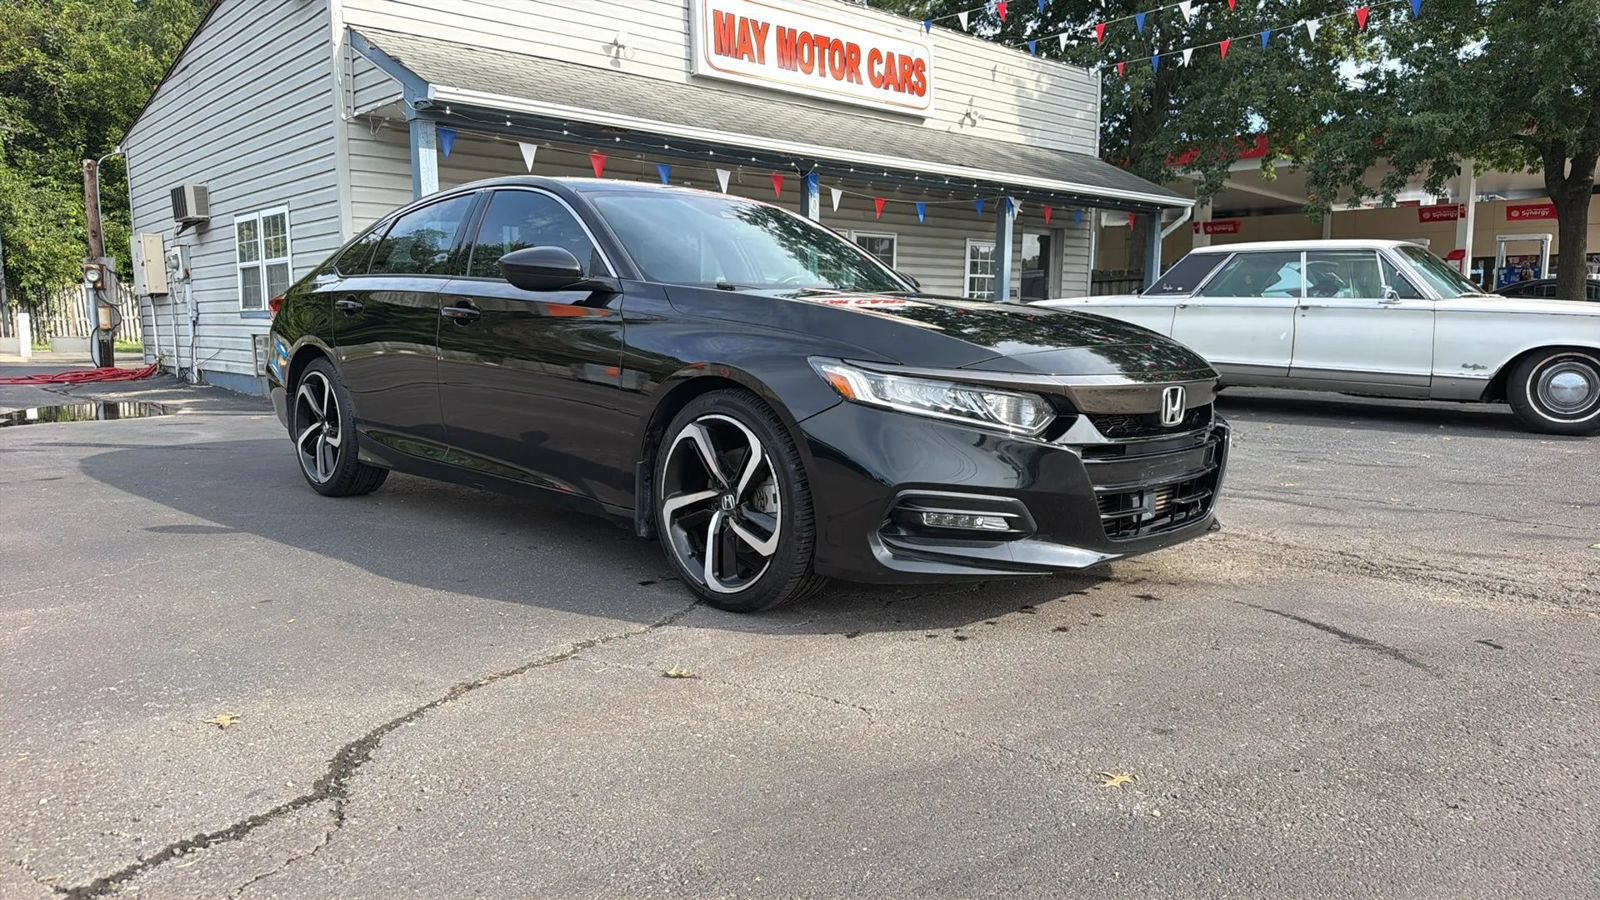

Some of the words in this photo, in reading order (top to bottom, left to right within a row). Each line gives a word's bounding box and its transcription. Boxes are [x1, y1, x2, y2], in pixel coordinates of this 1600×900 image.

[713, 9, 770, 65] MAY
[776, 25, 863, 85] MOTOR
[867, 47, 927, 97] CARS
[1521, 209, 1550, 217] Synergy
